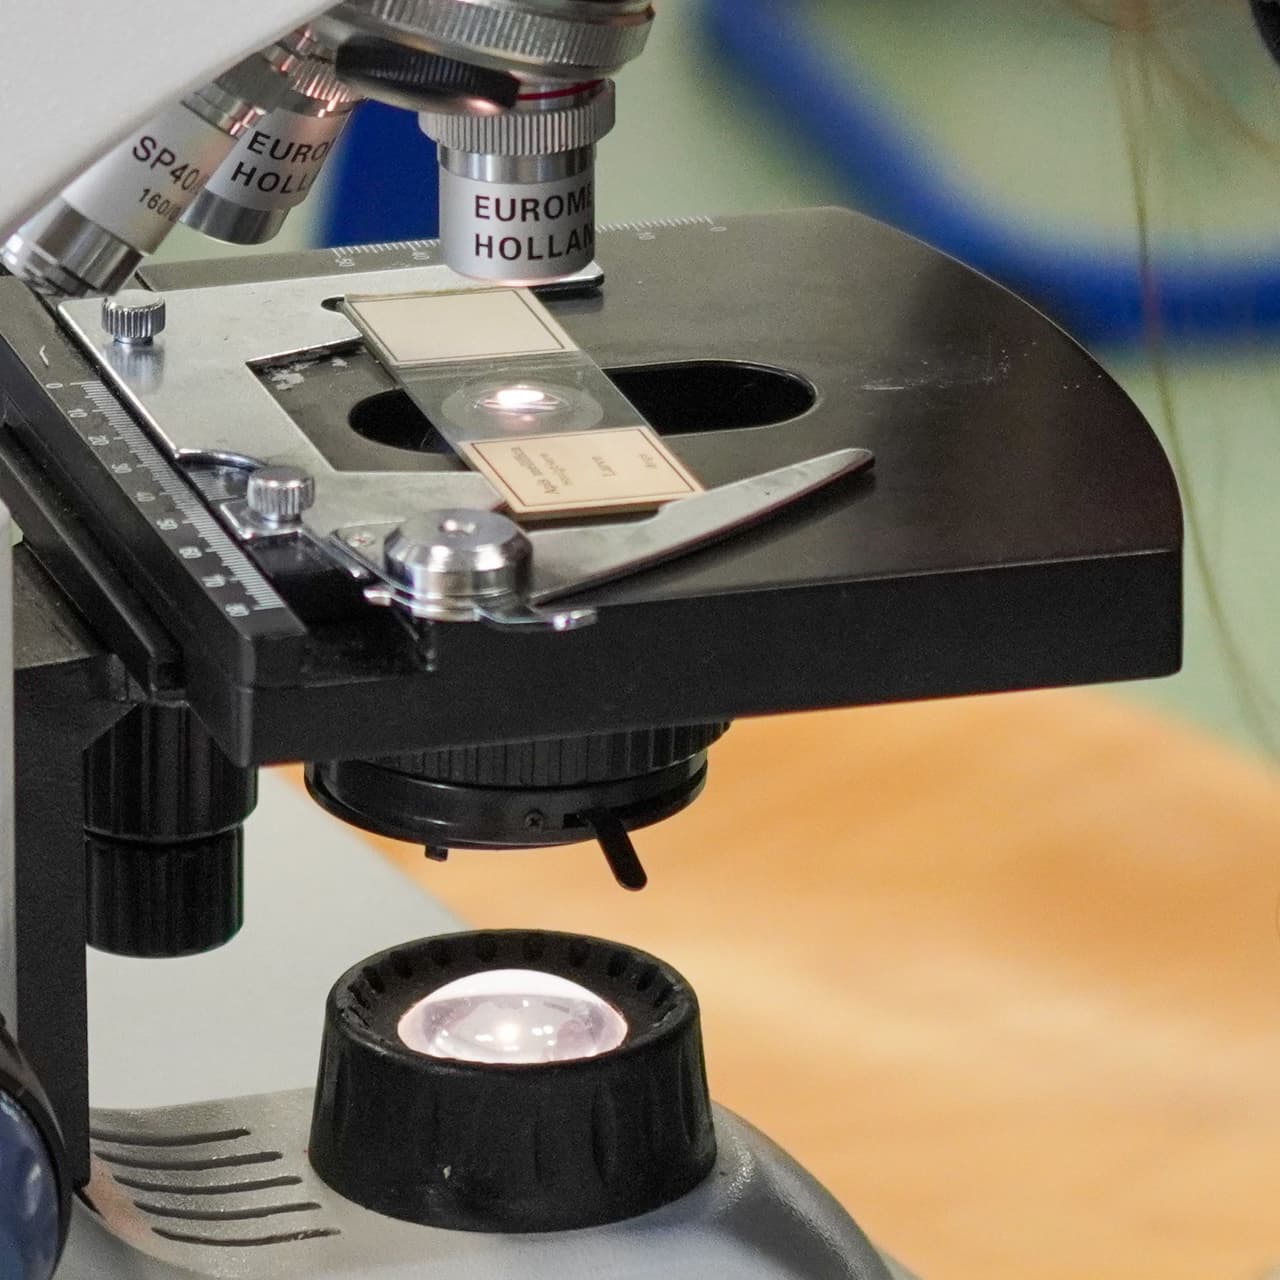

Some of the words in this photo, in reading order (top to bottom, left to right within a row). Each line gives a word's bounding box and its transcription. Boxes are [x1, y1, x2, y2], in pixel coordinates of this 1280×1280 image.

[247, 131, 336, 163] EURO
[132, 135, 204, 193] SP40
[231, 162, 320, 195] HOLL
